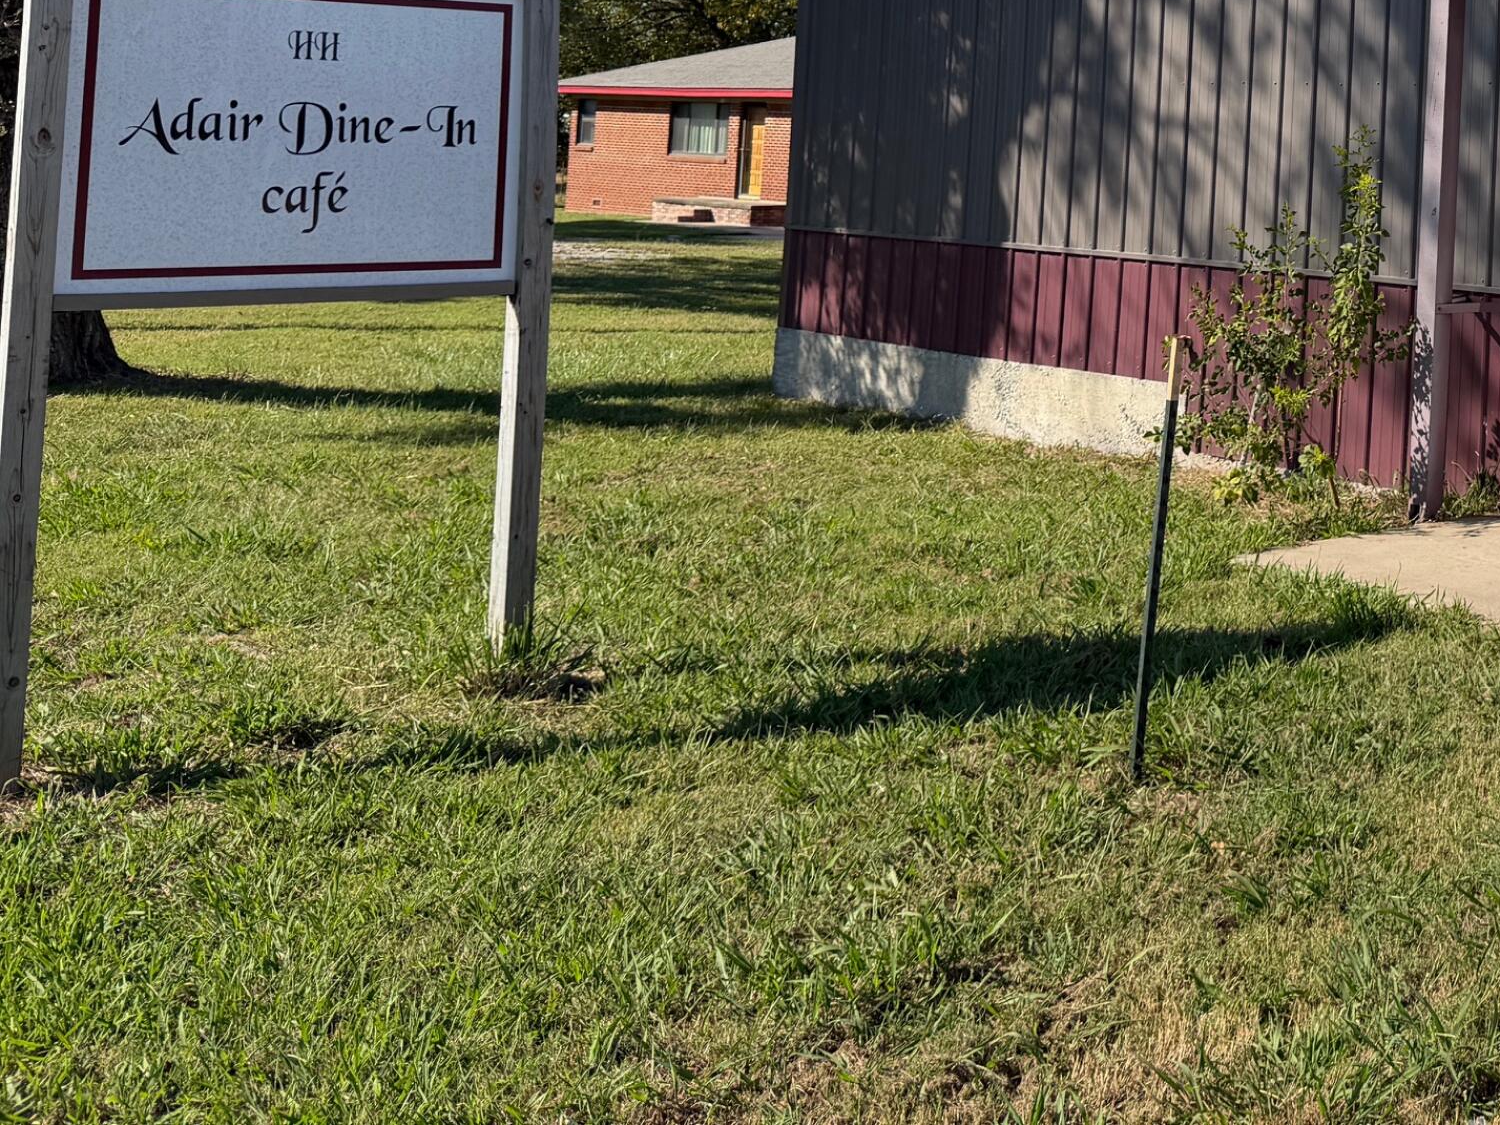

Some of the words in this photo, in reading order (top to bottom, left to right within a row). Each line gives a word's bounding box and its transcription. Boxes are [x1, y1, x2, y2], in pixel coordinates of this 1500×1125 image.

[287, 29, 341, 62] HH
[118, 97, 263, 155] Adair
[278, 100, 478, 155] Dine-In
[262, 171, 349, 234] café
